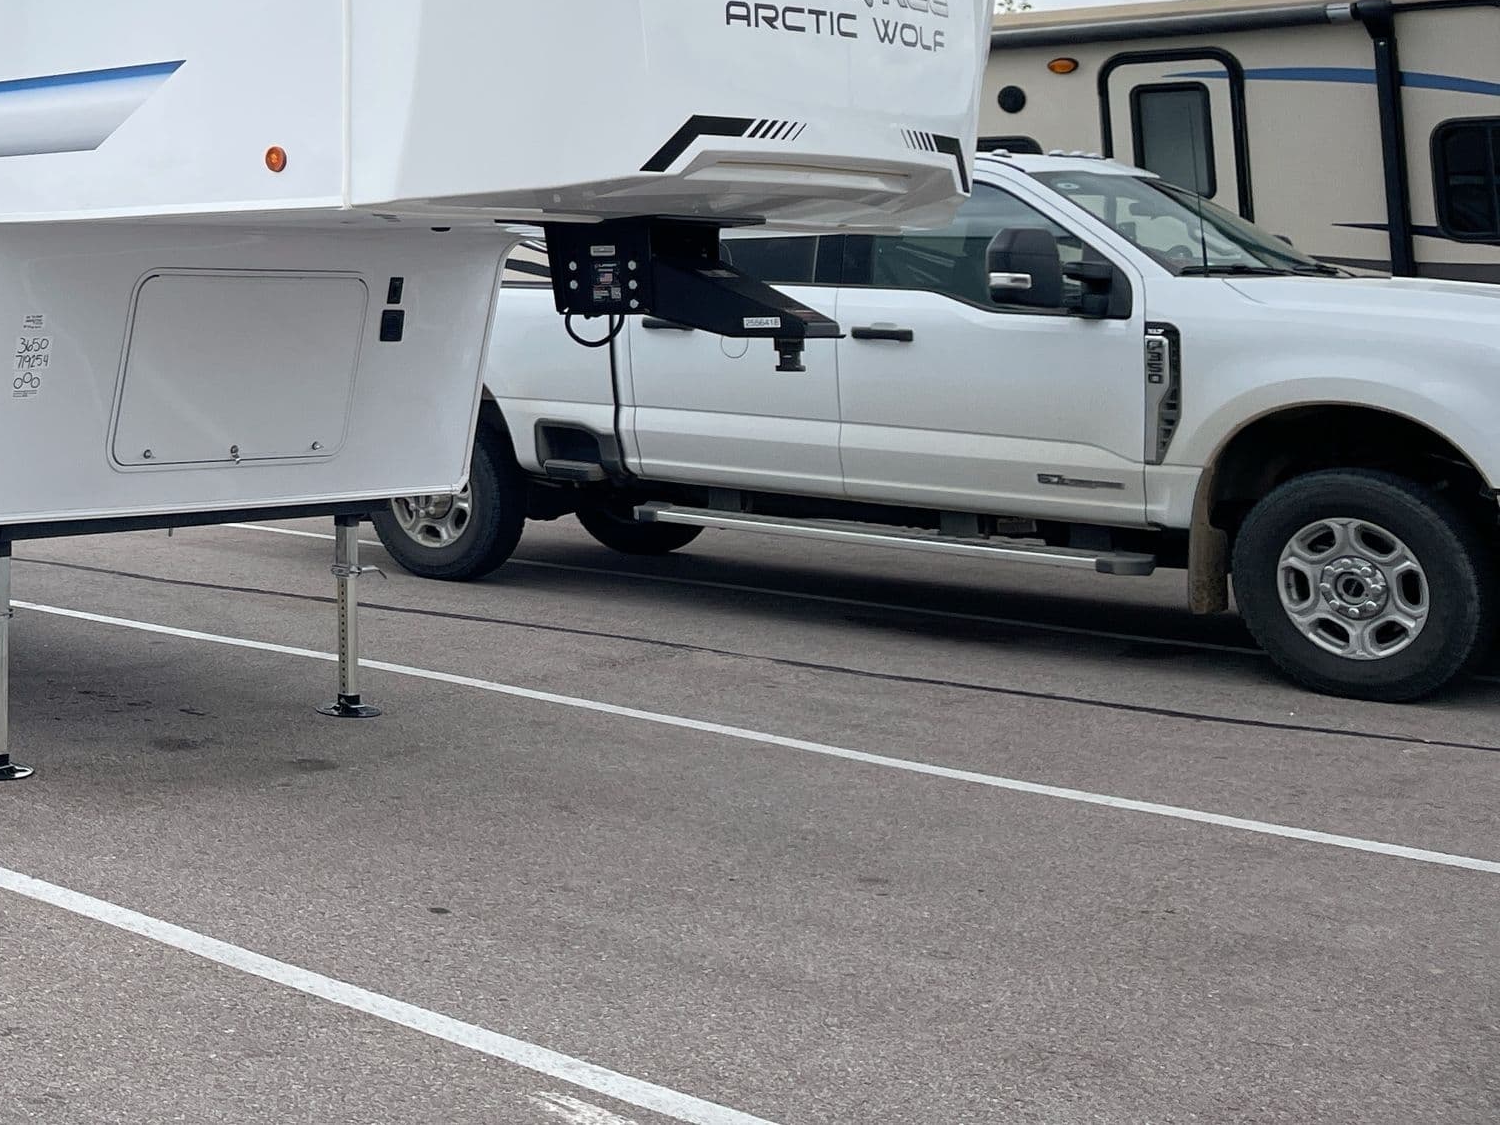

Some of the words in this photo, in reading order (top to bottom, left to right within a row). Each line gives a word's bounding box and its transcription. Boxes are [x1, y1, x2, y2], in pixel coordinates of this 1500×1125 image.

[725, 0, 859, 38] ARCTIC
[873, 17, 945, 52] WOLF
[17, 337, 49, 354] 3650
